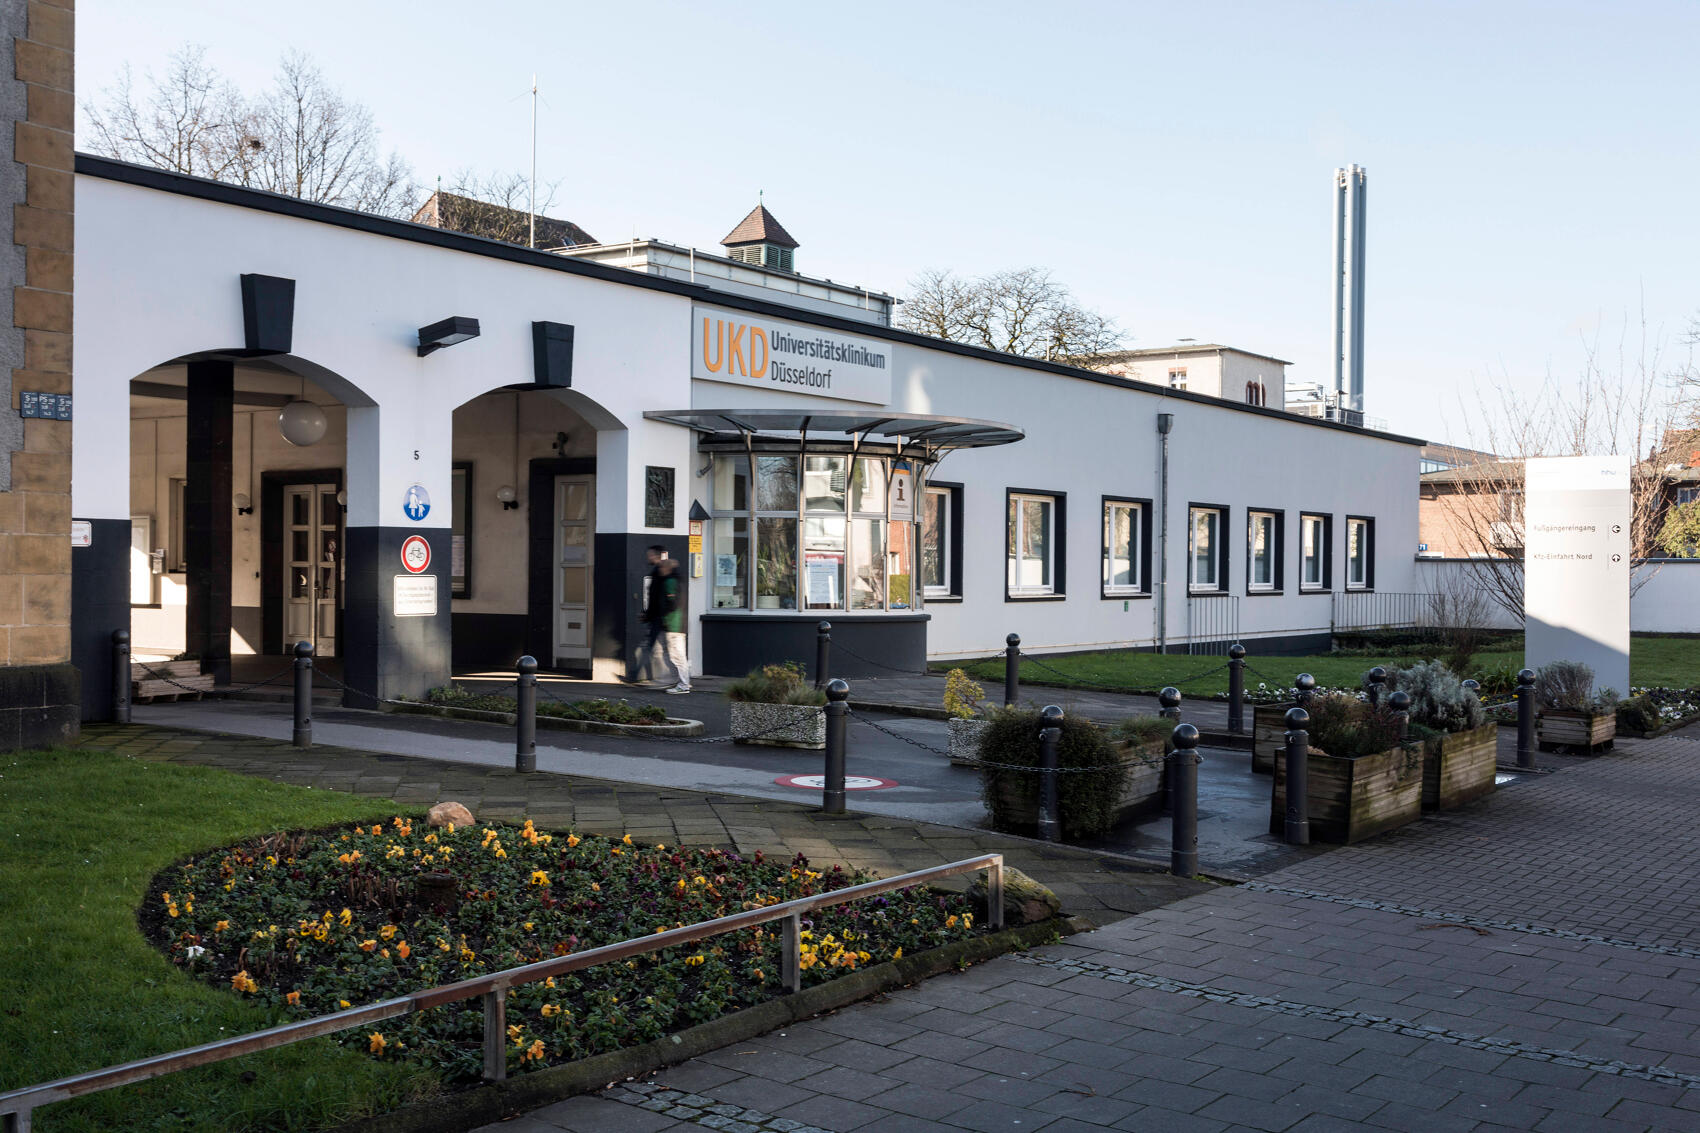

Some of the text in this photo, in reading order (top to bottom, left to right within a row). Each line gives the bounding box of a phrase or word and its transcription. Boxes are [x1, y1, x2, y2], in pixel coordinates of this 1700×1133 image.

[703, 317, 769, 379] UKD
[771, 329, 886, 370] Universitätsklinikum
[771, 360, 833, 389] Düsseldorf
[413, 450, 420, 460] 5
